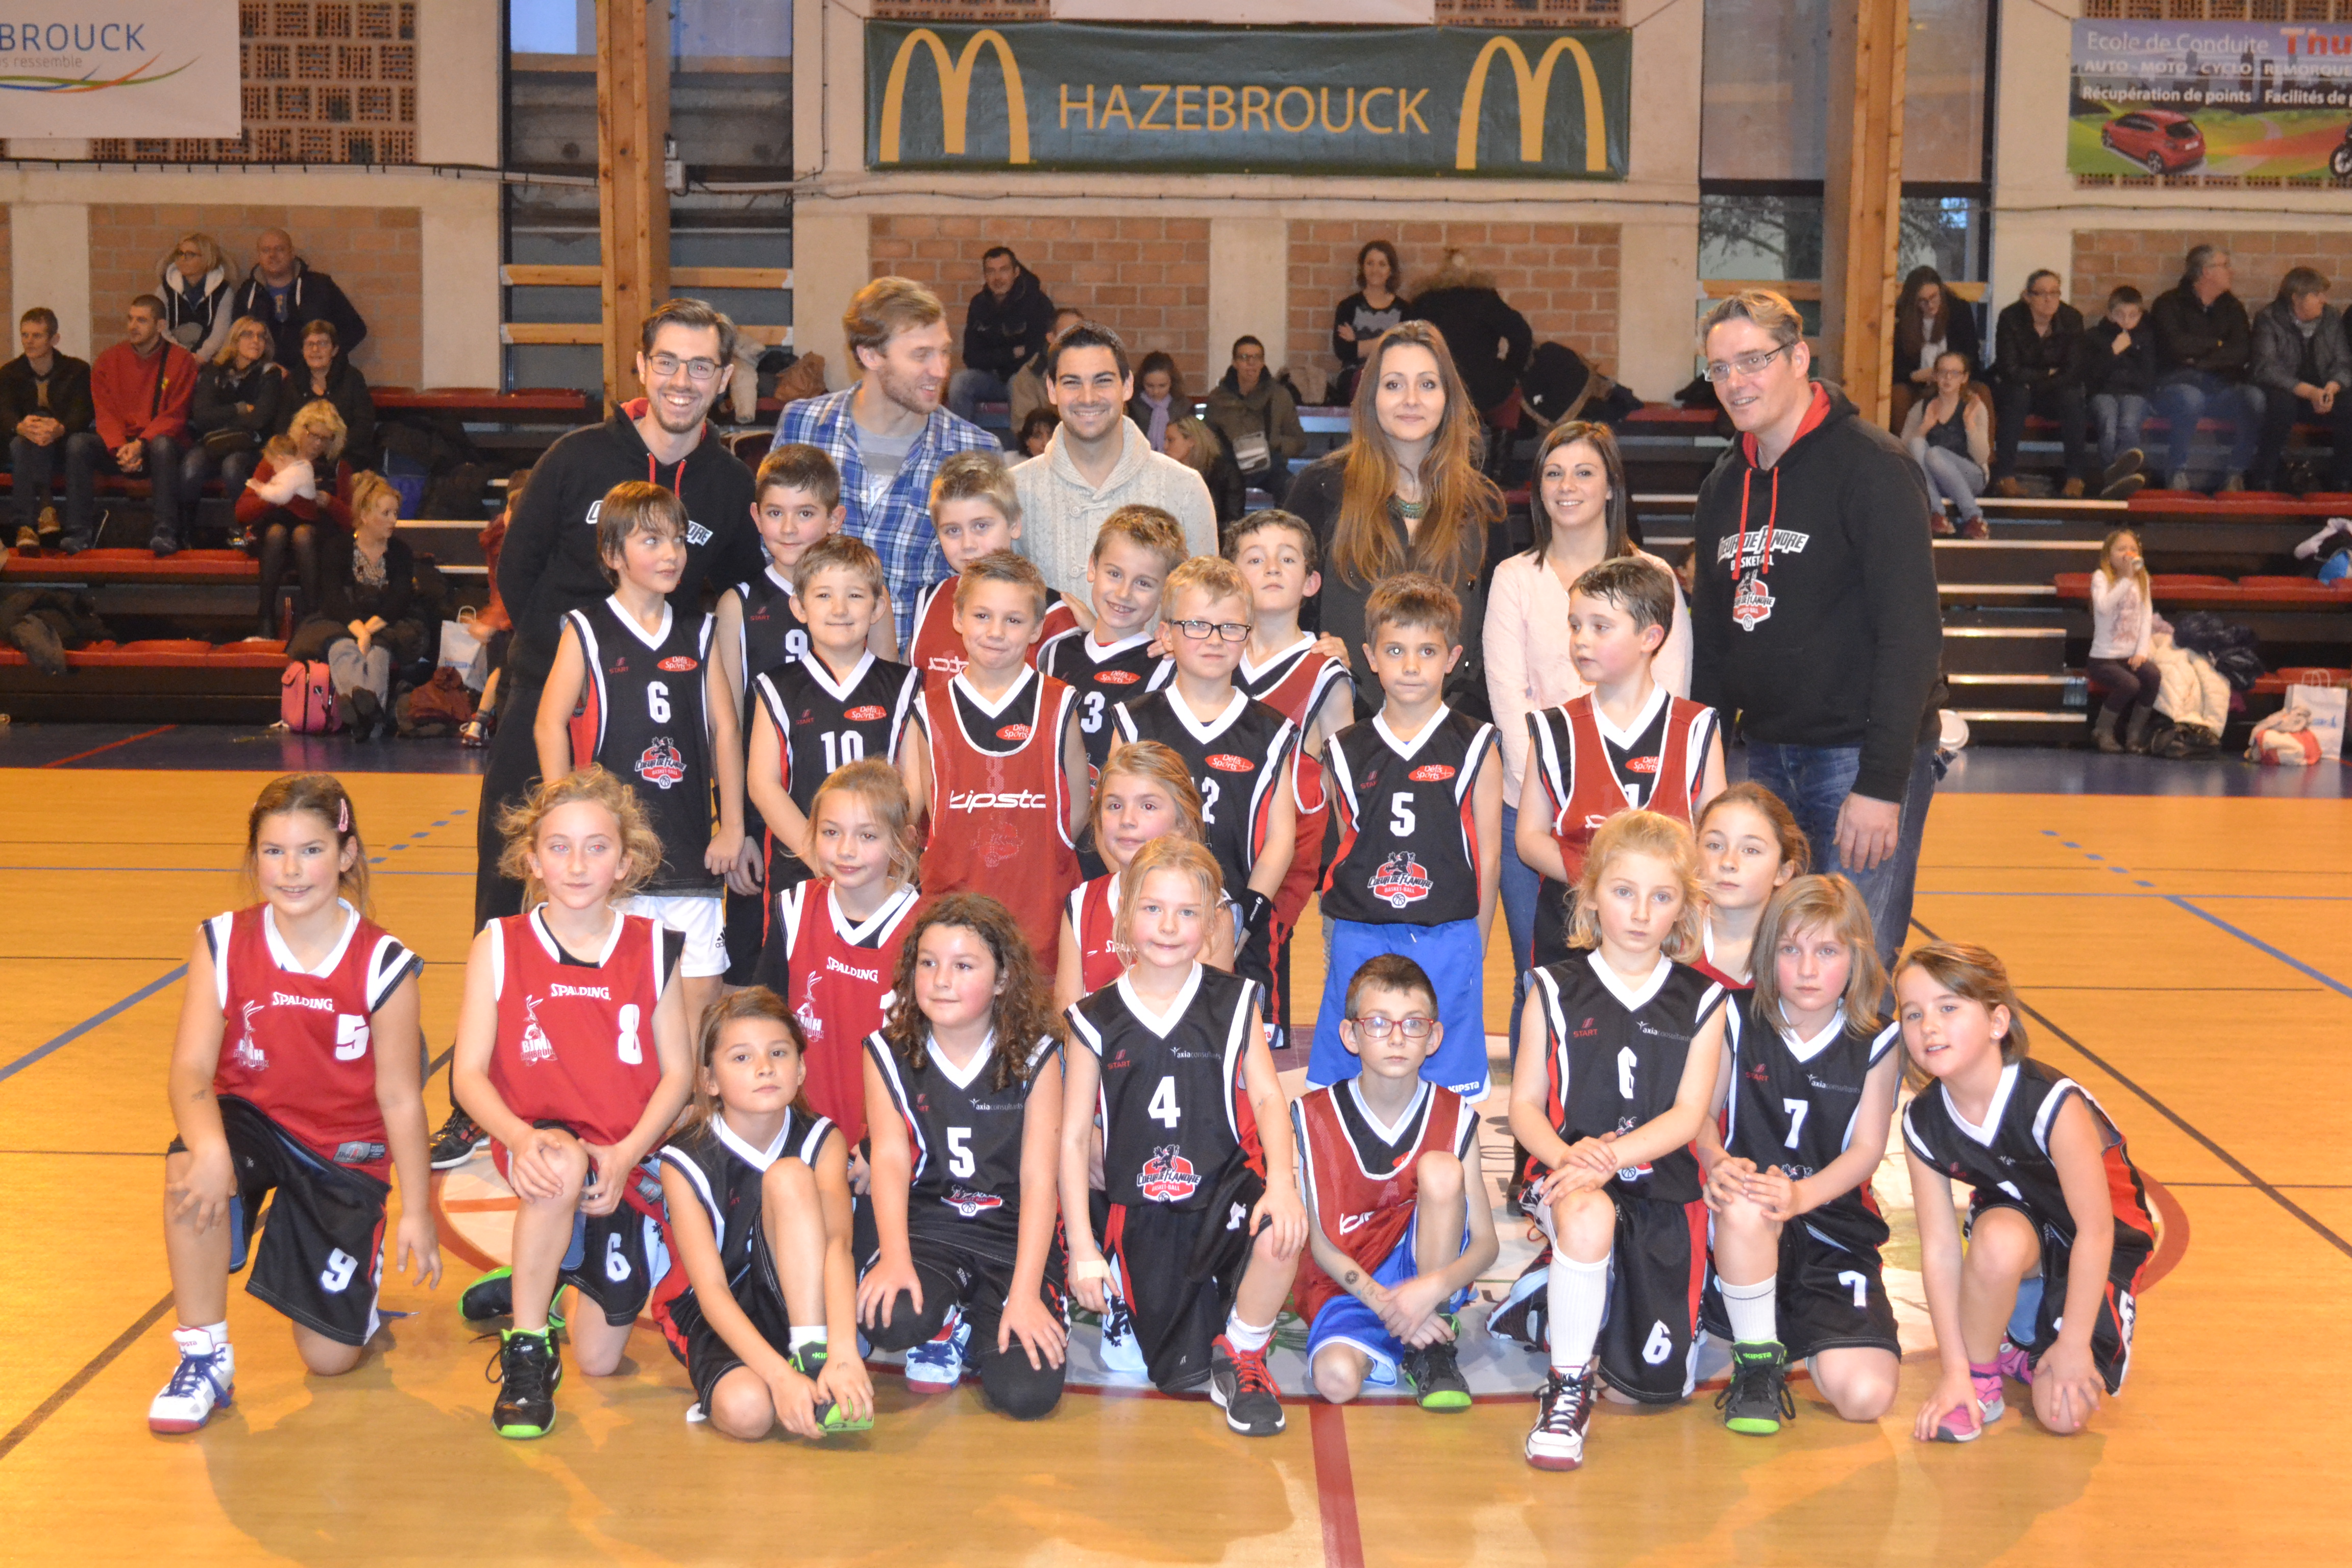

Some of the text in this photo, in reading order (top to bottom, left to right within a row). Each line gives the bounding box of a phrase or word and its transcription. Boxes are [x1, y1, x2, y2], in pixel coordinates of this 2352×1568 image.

[0, 23, 145, 51] BROUCK
[2088, 31, 2141, 51] Ecole
[2146, 33, 2171, 51] de
[2177, 33, 2269, 54] Conduite
[14, 55, 82, 68] ressemble
[2085, 60, 2128, 73] AUTO
[2141, 61, 2188, 75] MOTO
[2201, 62, 2252, 76] CYCLO
[2082, 85, 2181, 103] Récupération
[2184, 87, 2202, 103] de
[2206, 88, 2252, 106] points
[2265, 89, 2324, 105] Facilités
[2327, 90, 2347, 105] de
[1059, 83, 1429, 134] HAZEBROUCK
[665, 661, 686, 670] Sports
[1100, 674, 1123, 683] Sports
[647, 681, 671, 723] 6
[1080, 691, 1106, 733] 3
[851, 711, 875, 719] Sports
[820, 730, 864, 773] 10
[1222, 754, 1242, 765] Défis
[1212, 757, 1237, 771] Sports
[1415, 770, 1440, 779] Sports
[1424, 765, 1443, 773] Défis
[1390, 792, 1416, 837] 5
[1368, 875, 1390, 889] COEUR
[1399, 872, 1433, 890] FLANDRE
[827, 956, 878, 984] SPALDING
[272, 991, 335, 1013] SPALDING
[551, 983, 611, 1001] SPALDING
[335, 1014, 370, 1061] 5
[618, 1003, 643, 1065] 8
[1574, 1028, 1598, 1038] START
[1107, 1060, 1131, 1070] START
[1617, 1046, 1637, 1099] 6
[1148, 1075, 1181, 1129] 4
[1782, 1098, 1808, 1149] 7
[947, 1126, 975, 1178] 5
[1152, 1184, 1180, 1192] BASKET-BALL
[1164, 1168, 1202, 1187] FLANDRE
[606, 1232, 631, 1282] 6
[321, 1247, 358, 1293] 9
[956, 1267, 968, 1288] START
[1837, 1270, 1868, 1307] 7
[1642, 1318, 1672, 1364] 6
